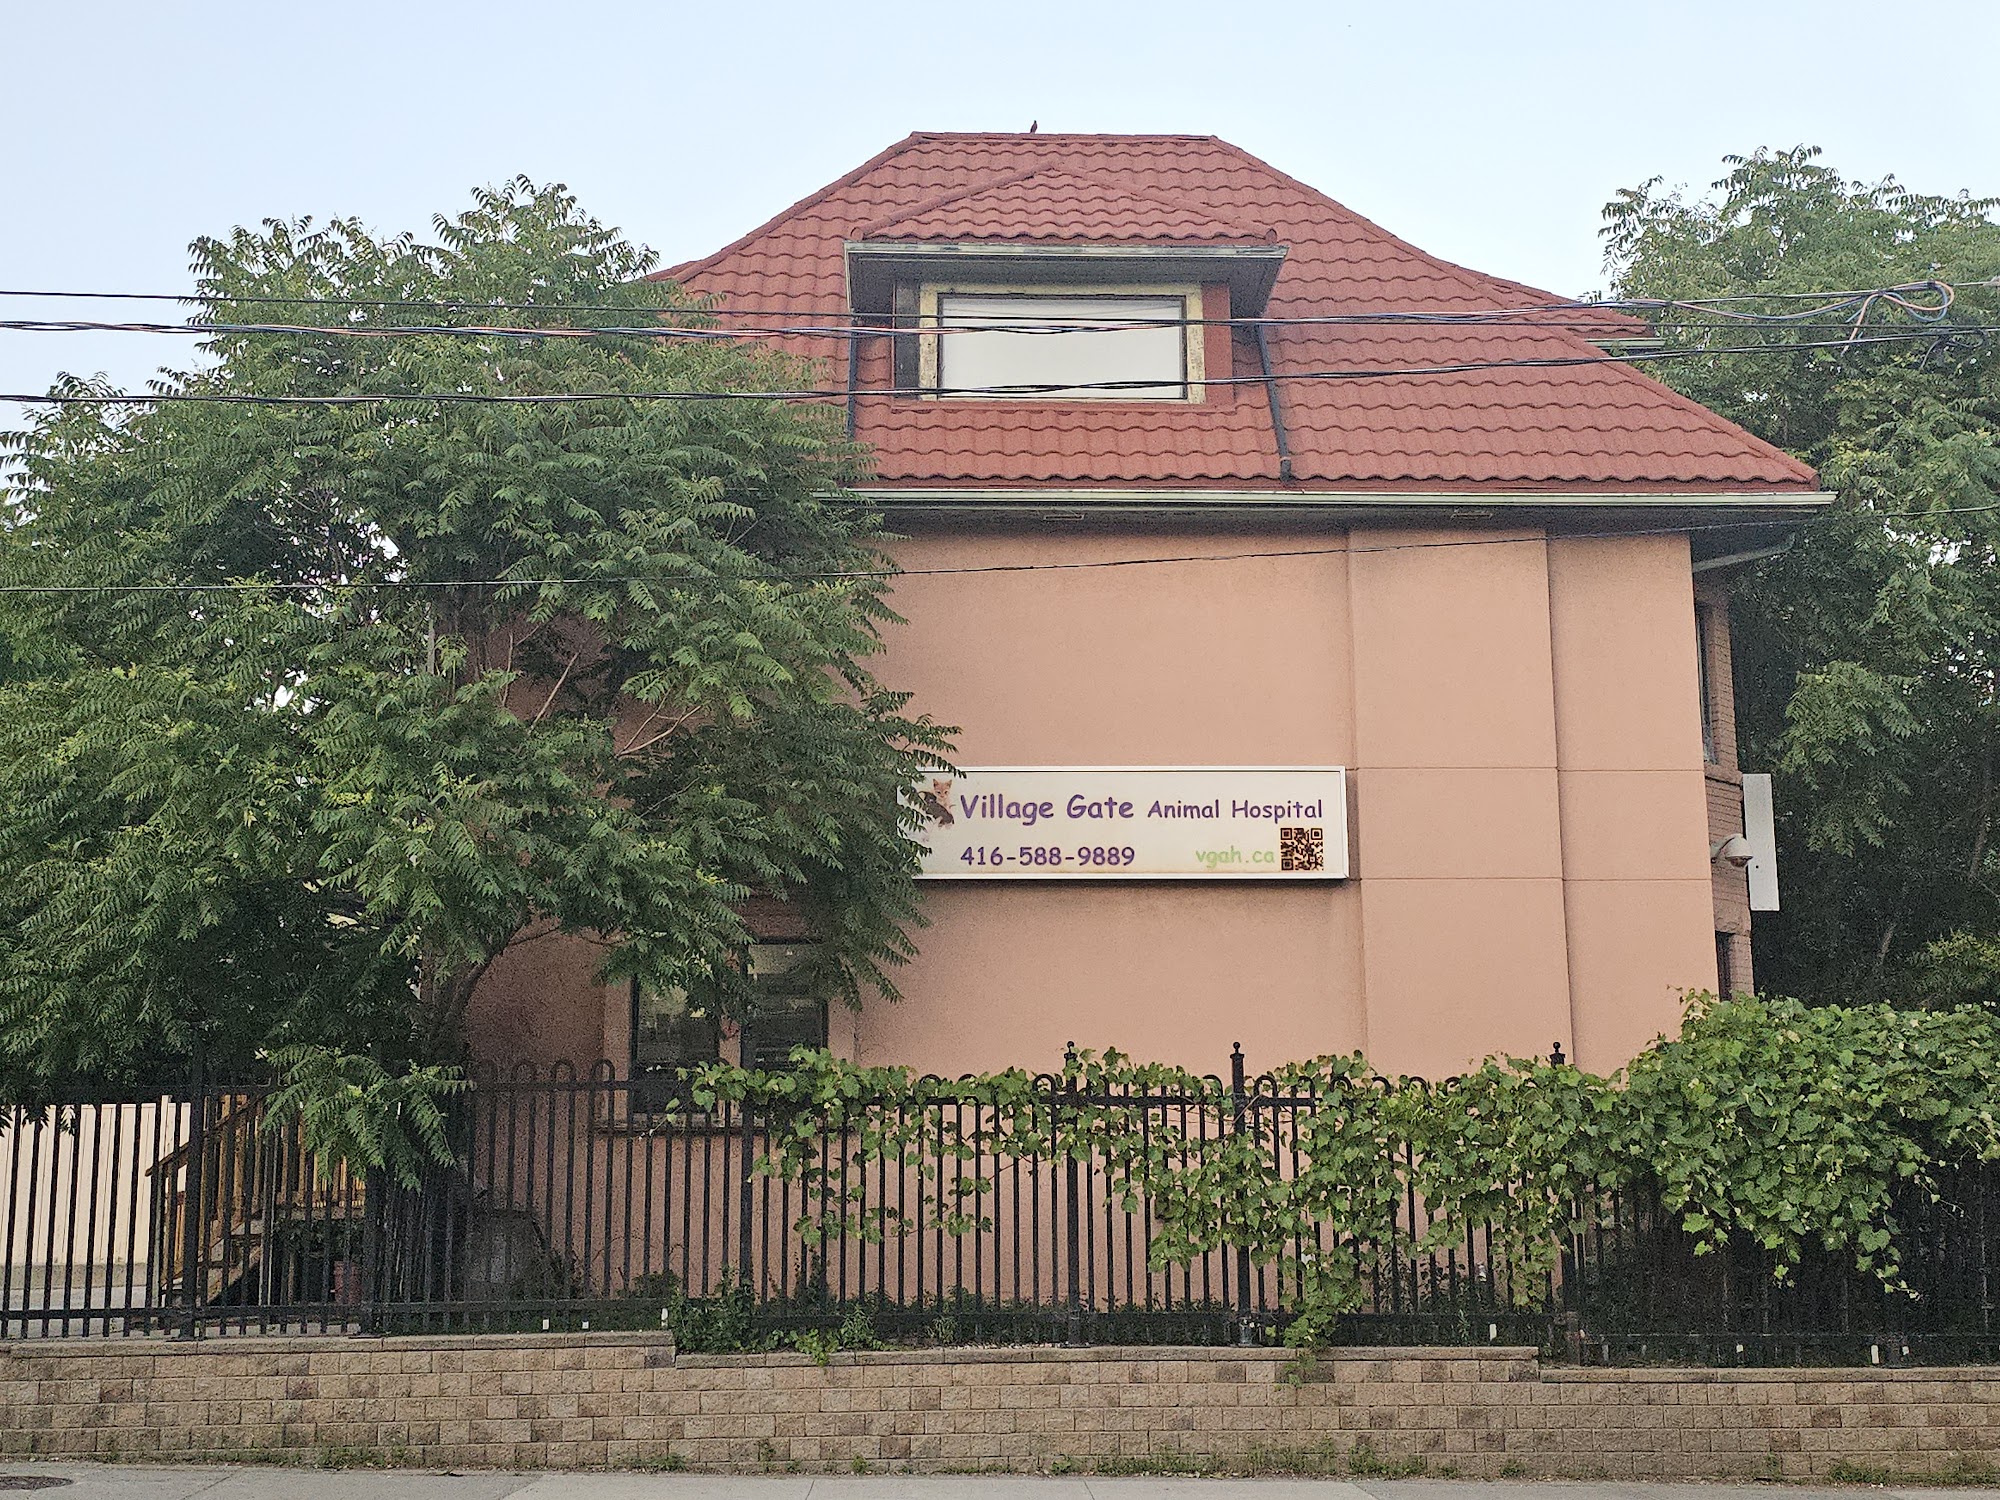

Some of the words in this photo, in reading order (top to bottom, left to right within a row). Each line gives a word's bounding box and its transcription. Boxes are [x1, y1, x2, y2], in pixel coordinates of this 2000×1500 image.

[960, 794, 1054, 825] Village
[1066, 794, 1135, 820] Gate
[1147, 800, 1220, 820] Animal
[1231, 800, 1323, 824] Hospital
[960, 846, 1135, 867] 416-588-9889
[1195, 846, 1275, 869] vgah.ca
